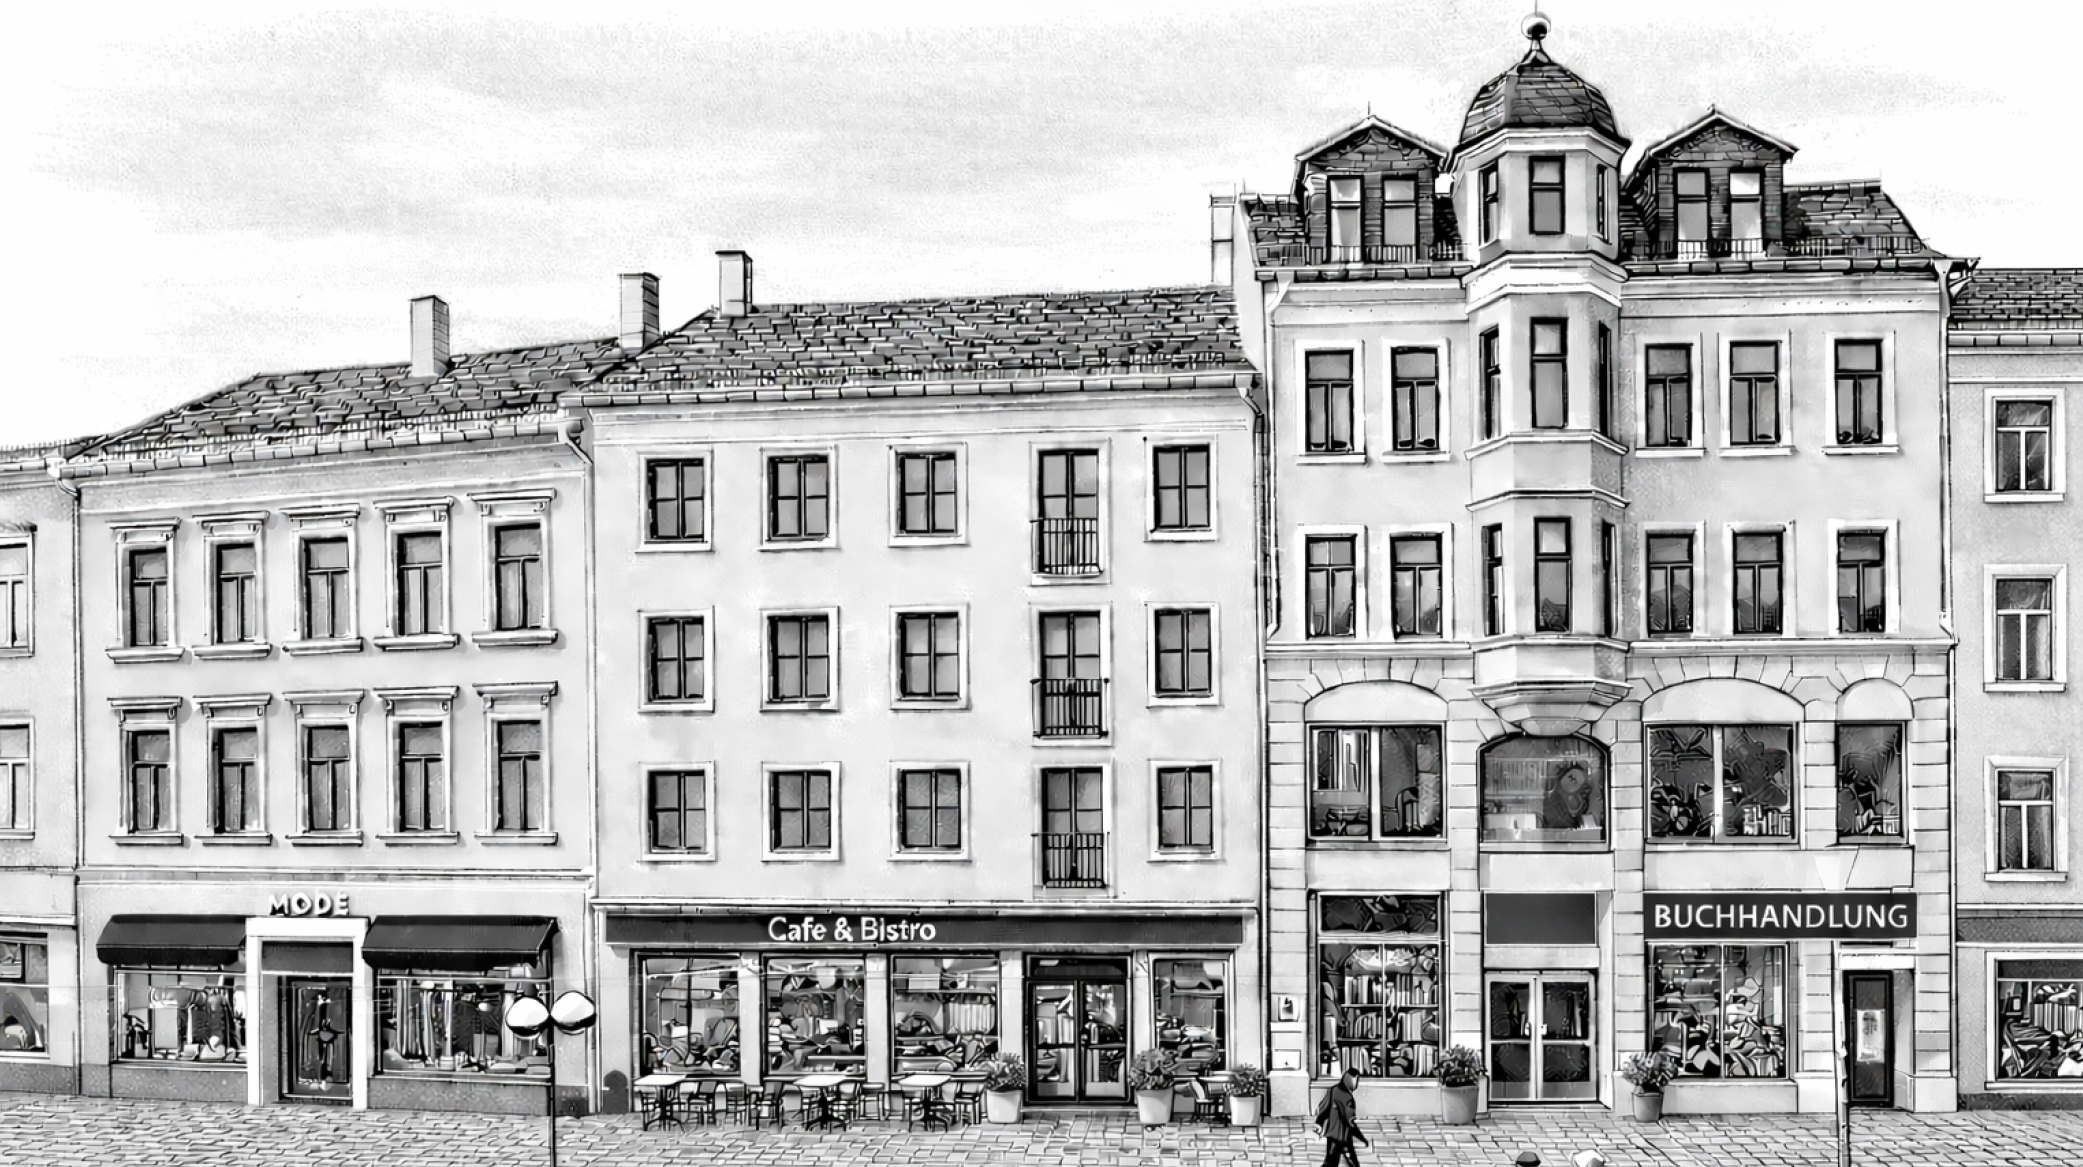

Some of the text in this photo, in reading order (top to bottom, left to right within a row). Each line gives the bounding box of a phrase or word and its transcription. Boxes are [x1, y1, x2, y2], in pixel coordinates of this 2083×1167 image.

[269, 892, 349, 915] MODE
[1655, 904, 1908, 928] BUCHHANDLUNG
[768, 916, 937, 942] Cafe & Bistro
